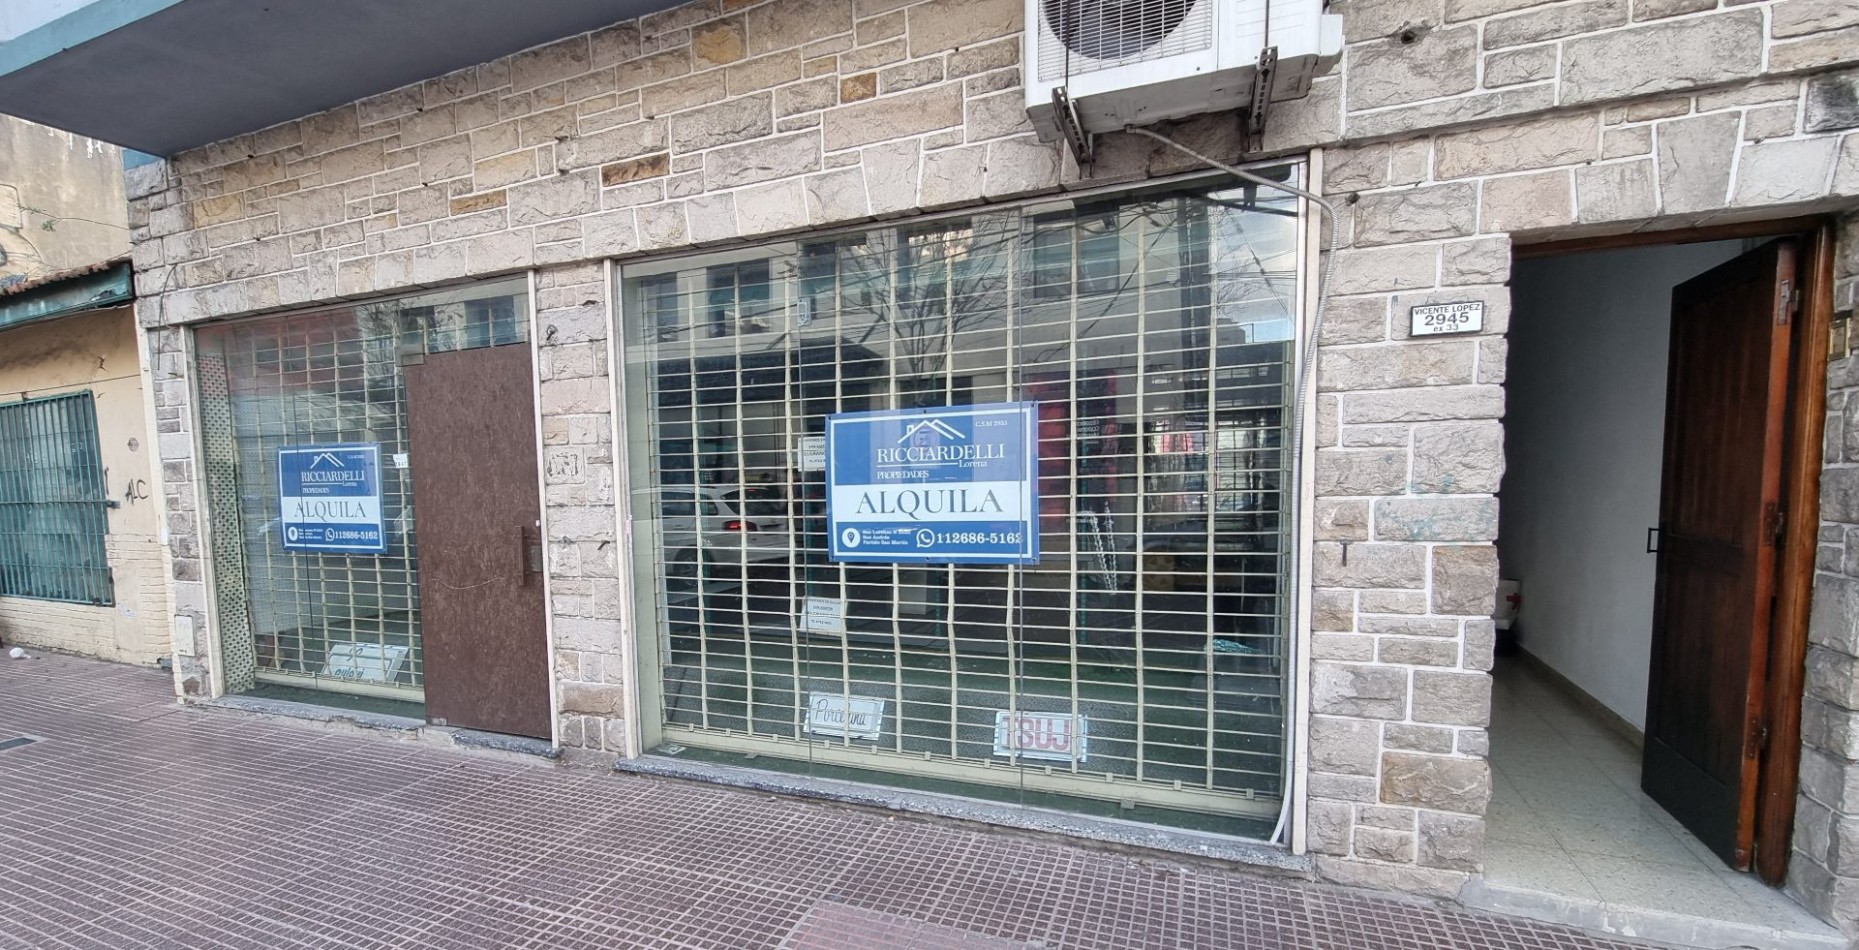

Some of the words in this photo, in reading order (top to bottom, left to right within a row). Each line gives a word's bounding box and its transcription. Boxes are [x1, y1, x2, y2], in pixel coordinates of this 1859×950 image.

[1414, 306, 1450, 315] VICENTE
[1452, 303, 1481, 313] LOPEZ
[1424, 312, 1470, 326] 2945
[876, 444, 1005, 463] RICCIARDELLI
[959, 459, 988, 468] Lorena
[301, 470, 365, 482] RICCIARDELLI
[876, 470, 930, 480] PROPIEDADES
[856, 489, 1004, 520] ALQUILA
[294, 501, 367, 522] ALQUILA
[937, 532, 1023, 545] 112686-5162
